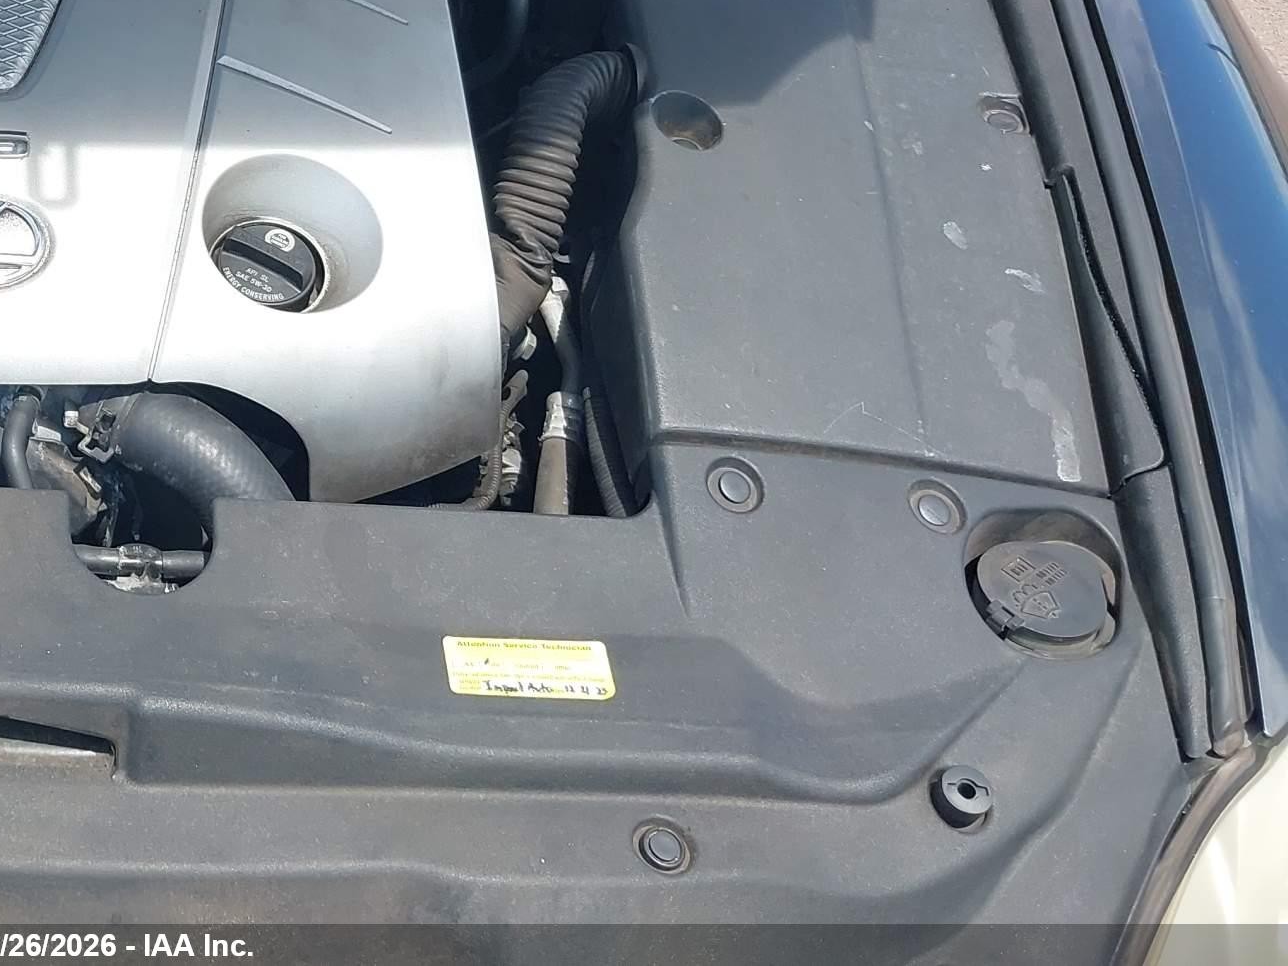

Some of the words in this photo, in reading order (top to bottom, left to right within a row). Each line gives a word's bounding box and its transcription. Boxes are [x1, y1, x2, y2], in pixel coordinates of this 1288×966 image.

[235, 271, 250, 282] SAE
[245, 267, 258, 276] API
[222, 266, 242, 288] ENERGY
[240, 286, 285, 302] CONSERVING
[541, 643, 592, 651] Technician
